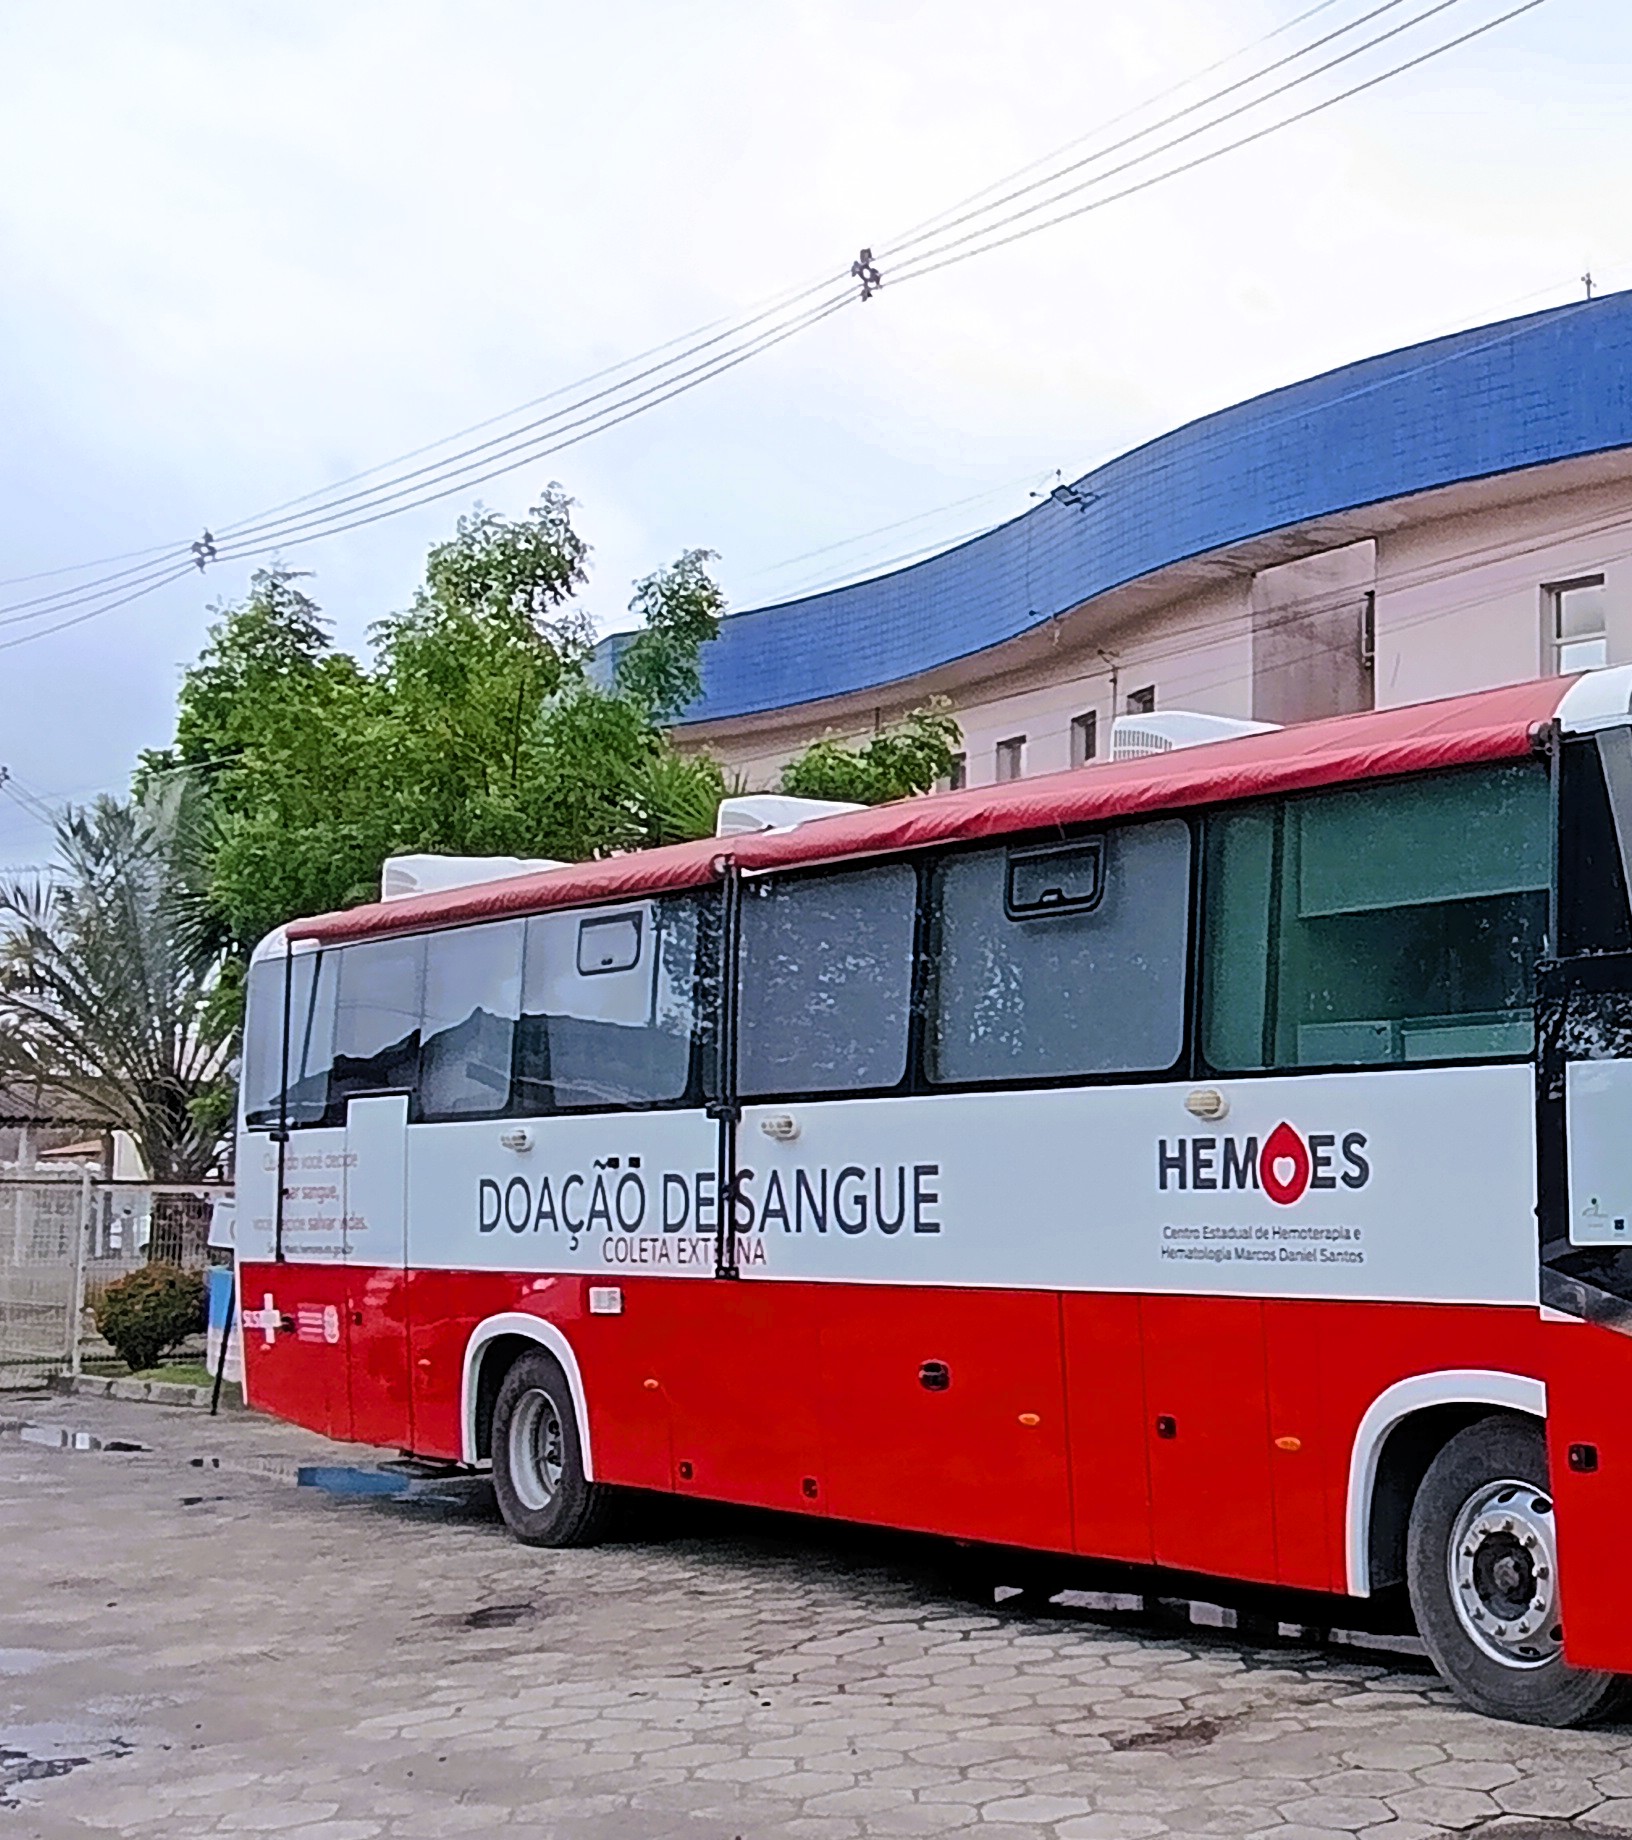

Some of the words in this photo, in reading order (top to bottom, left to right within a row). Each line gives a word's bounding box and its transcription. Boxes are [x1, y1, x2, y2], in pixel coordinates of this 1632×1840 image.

[478, 1157, 645, 1251] DOAÇÃO
[663, 1172, 718, 1234] DE
[735, 1165, 941, 1234] SANGUE
[1163, 1226, 1200, 1240] Centro
[1202, 1226, 1253, 1241] Estadual
[1255, 1225, 1270, 1241] de
[1272, 1225, 1351, 1243] Hemoterapia
[1352, 1227, 1361, 1241] e
[603, 1237, 671, 1263] COLETA
[677, 1237, 767, 1266] EXTNA
[1161, 1246, 1232, 1263] Hematologia
[1234, 1247, 1277, 1262] Marcos
[1279, 1248, 1317, 1263] Daniel
[1319, 1248, 1365, 1265] Santos
